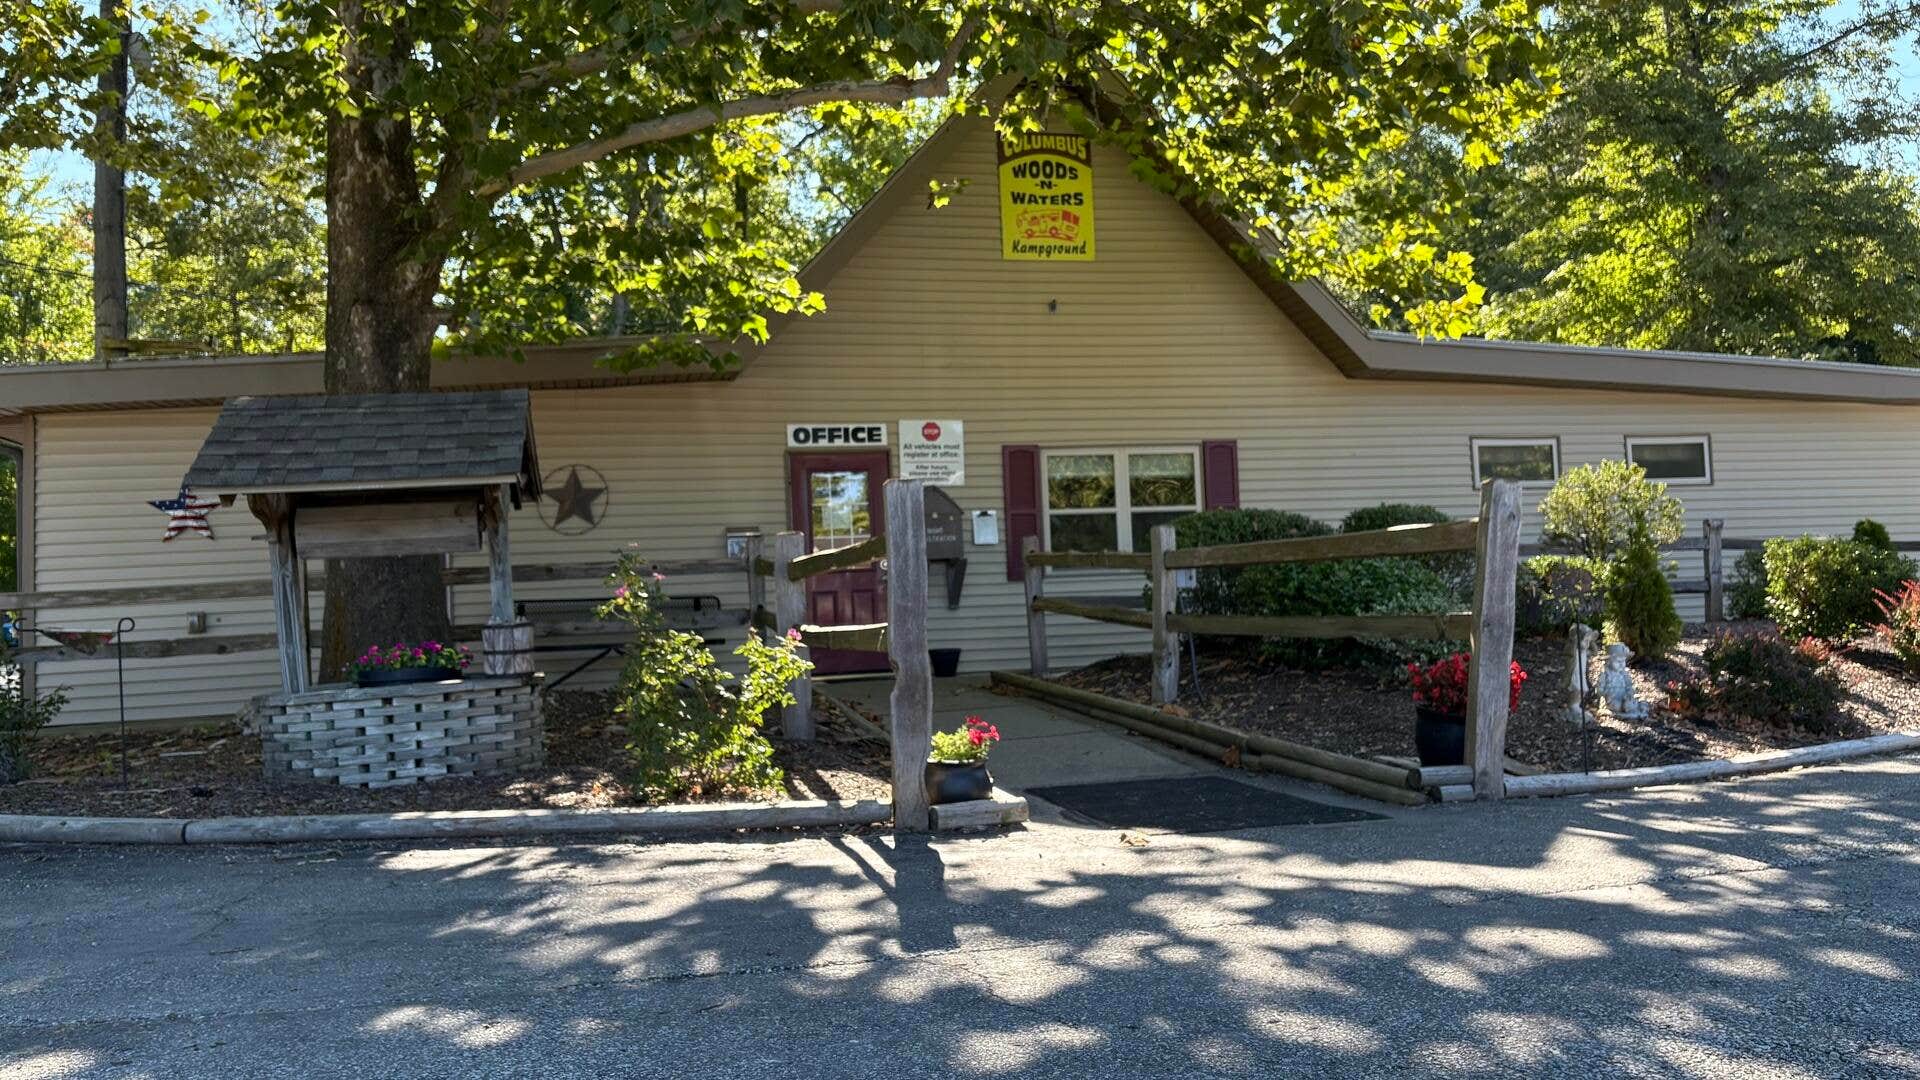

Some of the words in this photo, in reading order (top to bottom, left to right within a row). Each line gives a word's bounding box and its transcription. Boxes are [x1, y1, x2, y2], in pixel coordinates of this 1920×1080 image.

[1003, 135, 1088, 160] COLUMBUS
[1012, 160, 1079, 180] WOODS
[1010, 191, 1084, 206] WATERS
[1012, 240, 1086, 258] Kampground
[793, 426, 882, 444] OFFICE
[923, 428, 939, 436] STOP
[903, 451, 930, 459] register
